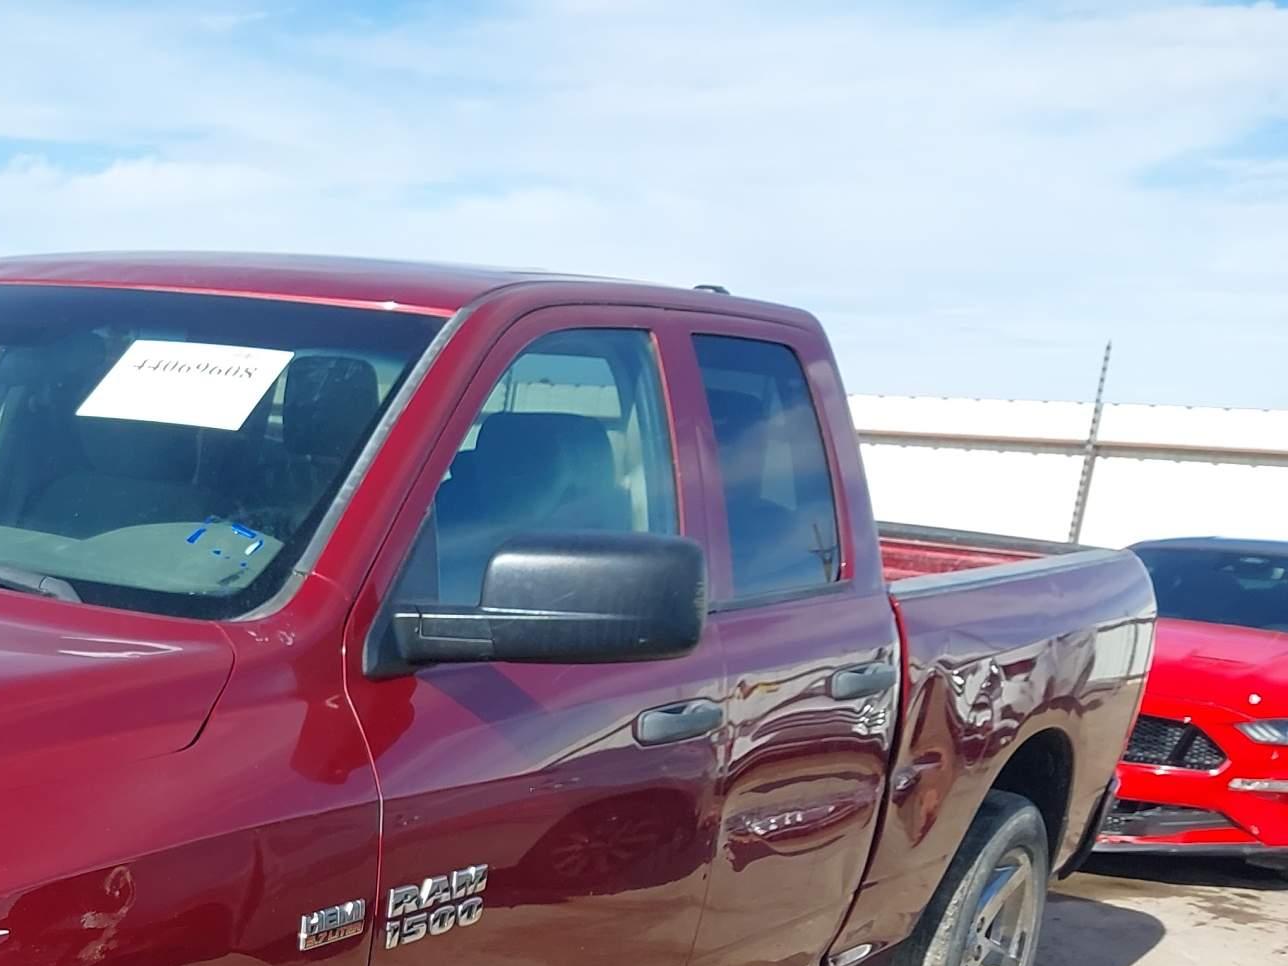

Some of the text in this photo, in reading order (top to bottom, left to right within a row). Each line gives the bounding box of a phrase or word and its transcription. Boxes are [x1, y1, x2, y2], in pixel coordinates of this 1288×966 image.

[300, 898, 366, 936] HEMI
[386, 863, 489, 919] RAM
[385, 897, 484, 950] 1500
